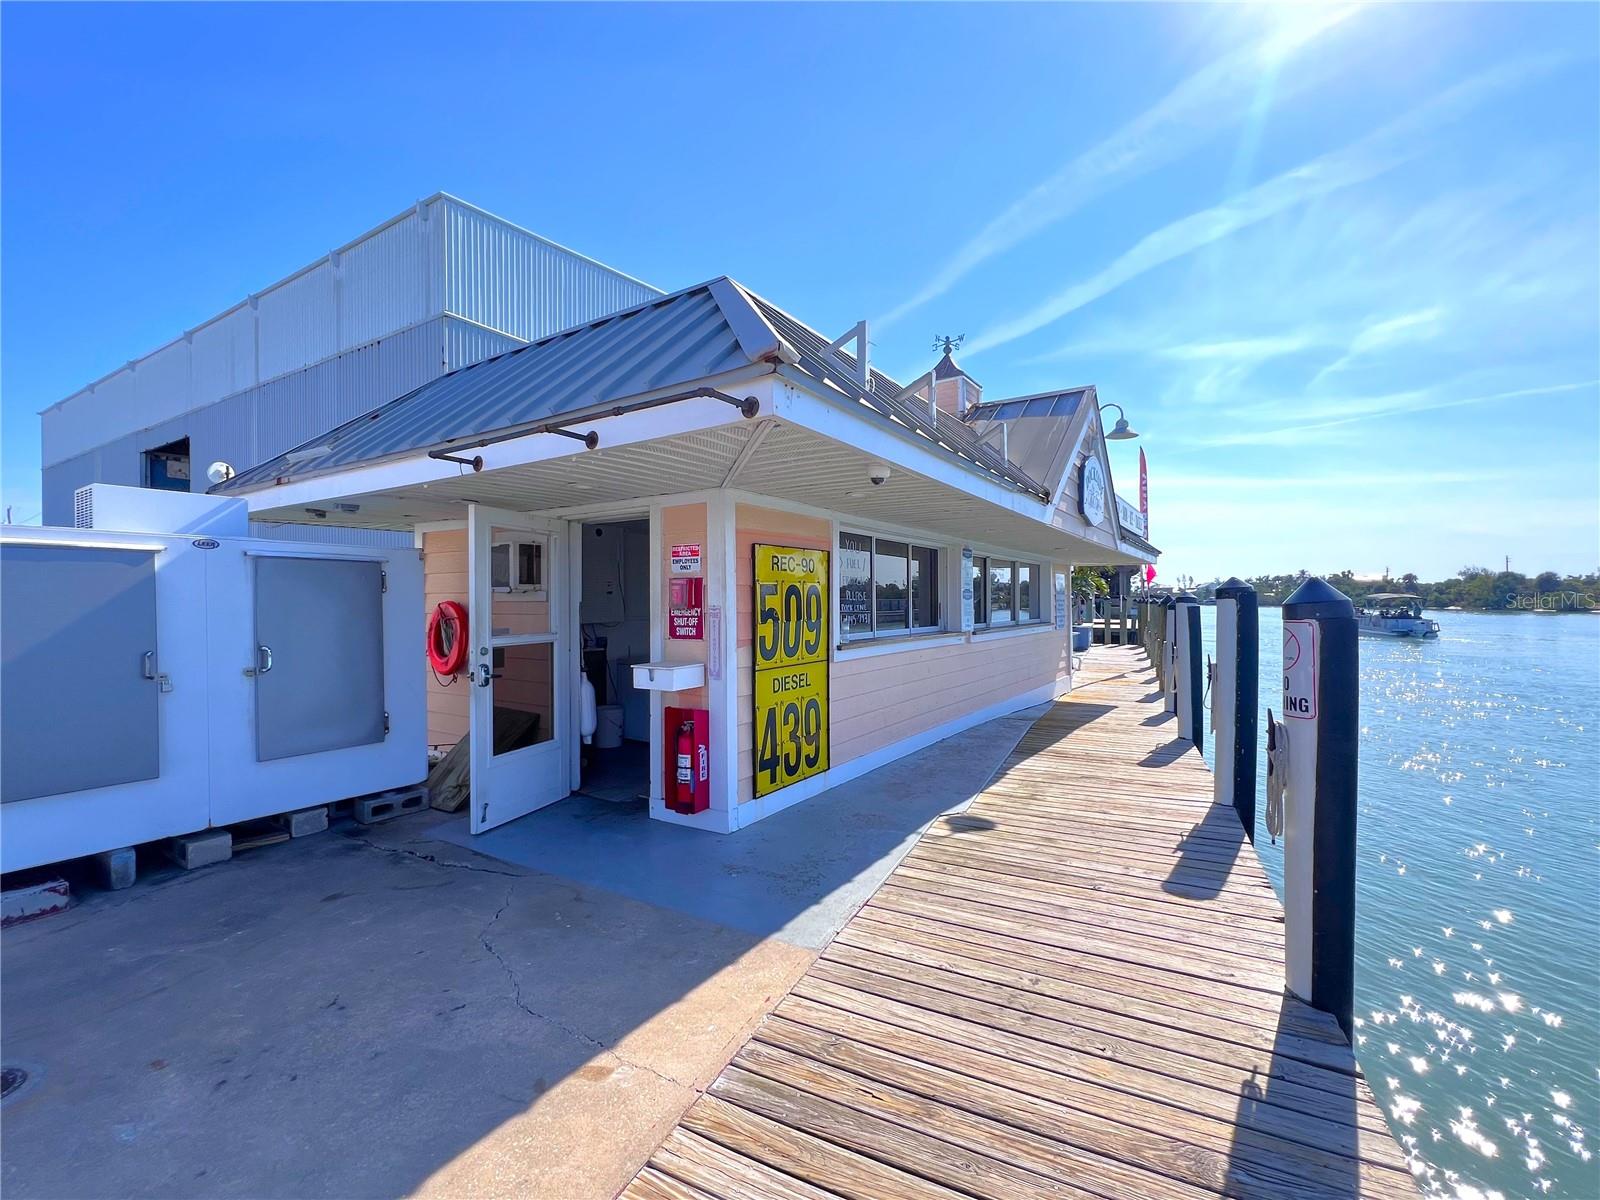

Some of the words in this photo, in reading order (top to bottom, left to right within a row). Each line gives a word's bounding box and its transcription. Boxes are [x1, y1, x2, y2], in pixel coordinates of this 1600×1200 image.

[771, 555, 815, 573] REC-90
[671, 607, 701, 616] EMERGENCY
[674, 617, 698, 626] SHUT-OFF
[759, 583, 821, 661] 509
[676, 627, 697, 636] SWITCH
[773, 673, 811, 693] DIESEL
[759, 698, 821, 785] 439
